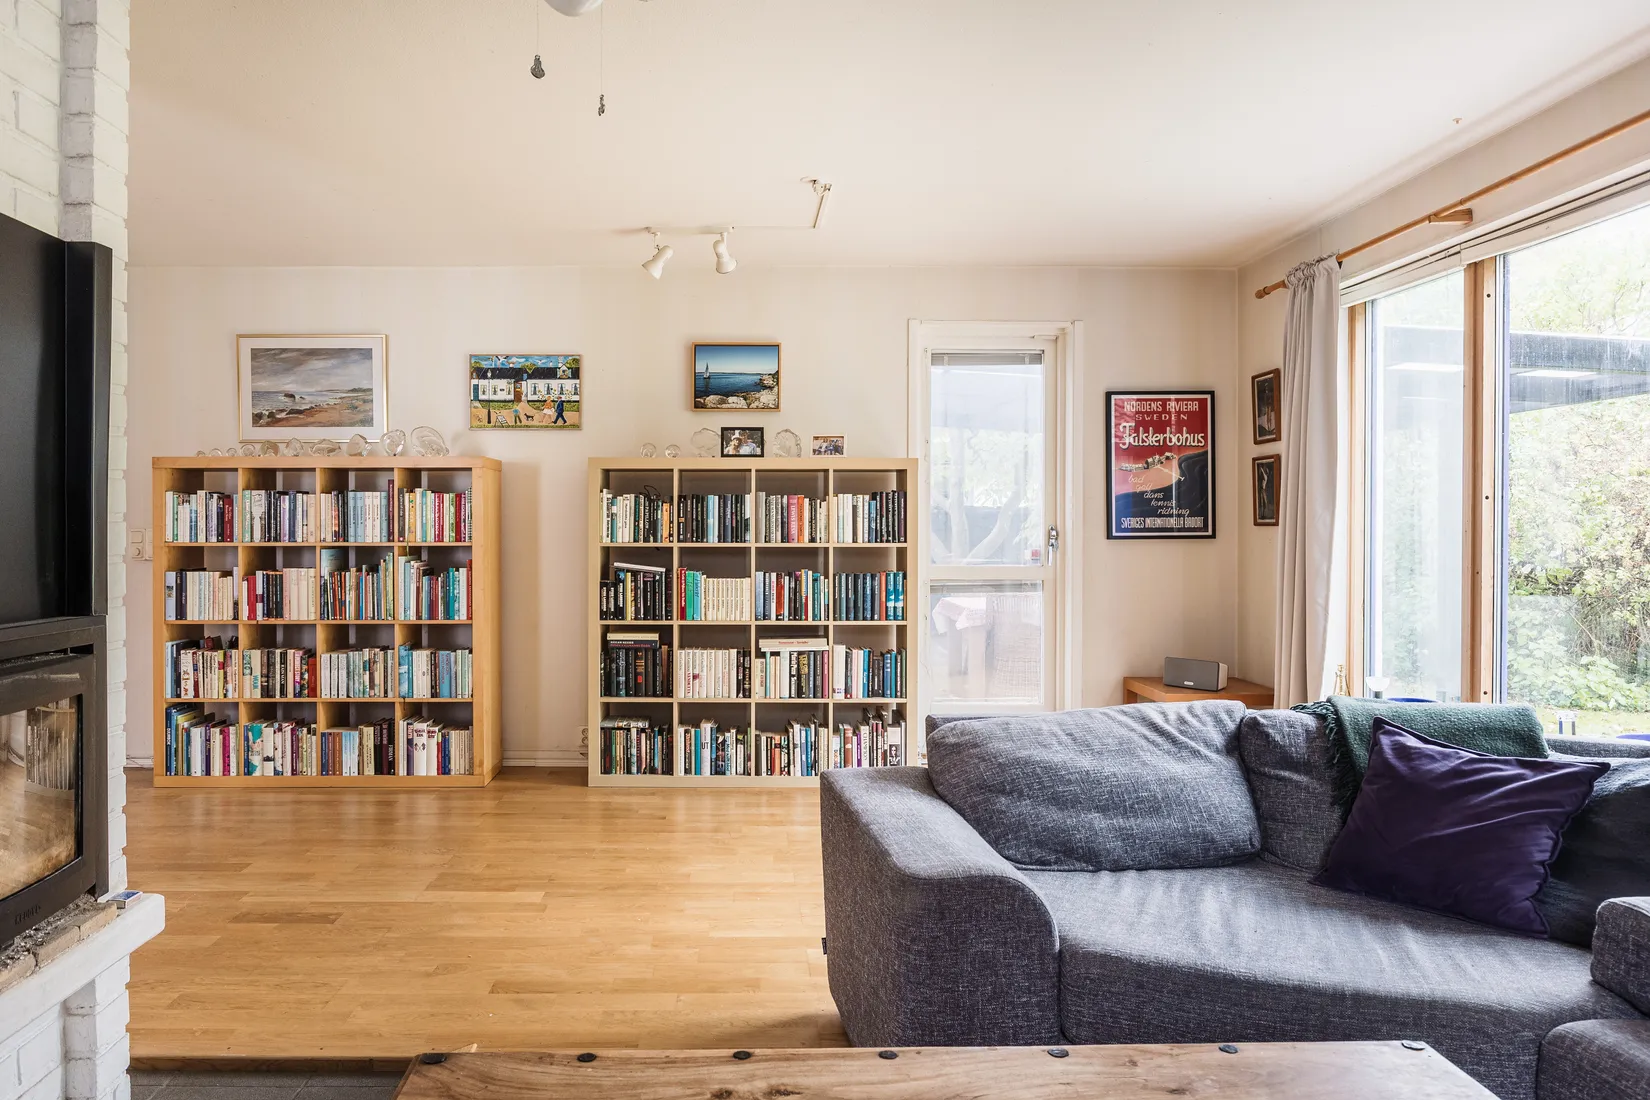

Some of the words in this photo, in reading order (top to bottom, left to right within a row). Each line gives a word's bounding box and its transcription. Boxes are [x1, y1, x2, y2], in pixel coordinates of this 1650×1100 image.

[1124, 401, 1162, 412] NORDENS
[1166, 401, 1198, 412] RIVIERA
[1120, 422, 1205, 449] Falsterbohus
[1128, 474, 1144, 484] bad
[1143, 490, 1164, 498] dans
[1150, 498, 1176, 507] tennis
[1157, 508, 1190, 518] ridning
[1120, 518, 1144, 528] SVERIGES
[1145, 517, 1184, 528] INTERNATIONELLA
